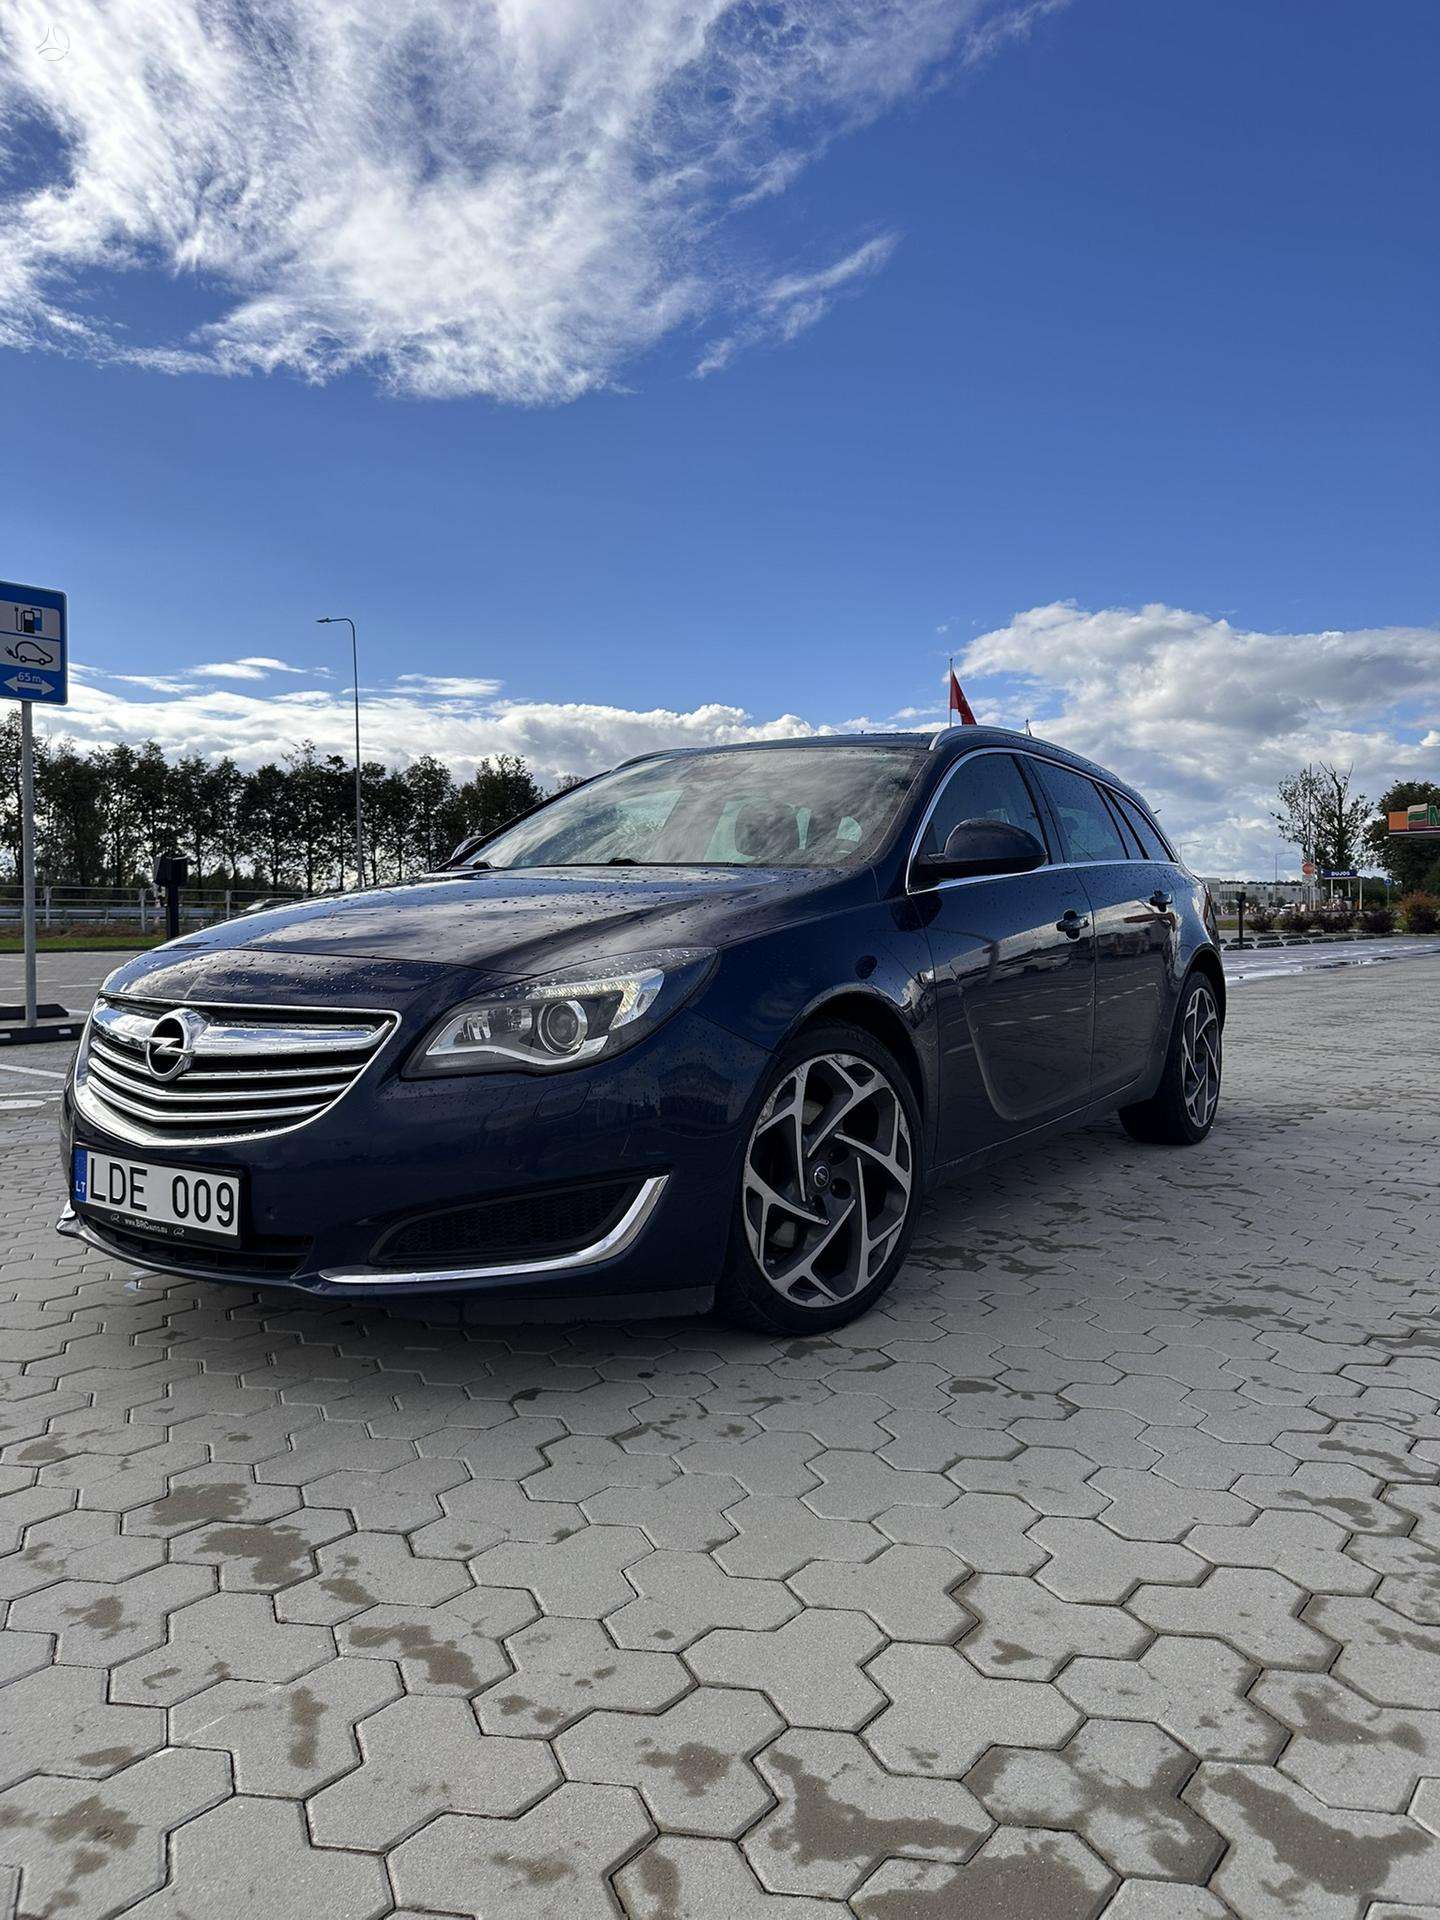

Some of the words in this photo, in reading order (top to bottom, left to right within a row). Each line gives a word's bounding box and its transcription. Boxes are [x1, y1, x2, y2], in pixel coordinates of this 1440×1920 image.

[18, 672, 31, 681] 65
[32, 675, 41, 683] m
[75, 1180, 86, 1193] LT
[90, 1157, 148, 1212] LDE
[172, 1175, 234, 1227] 009
